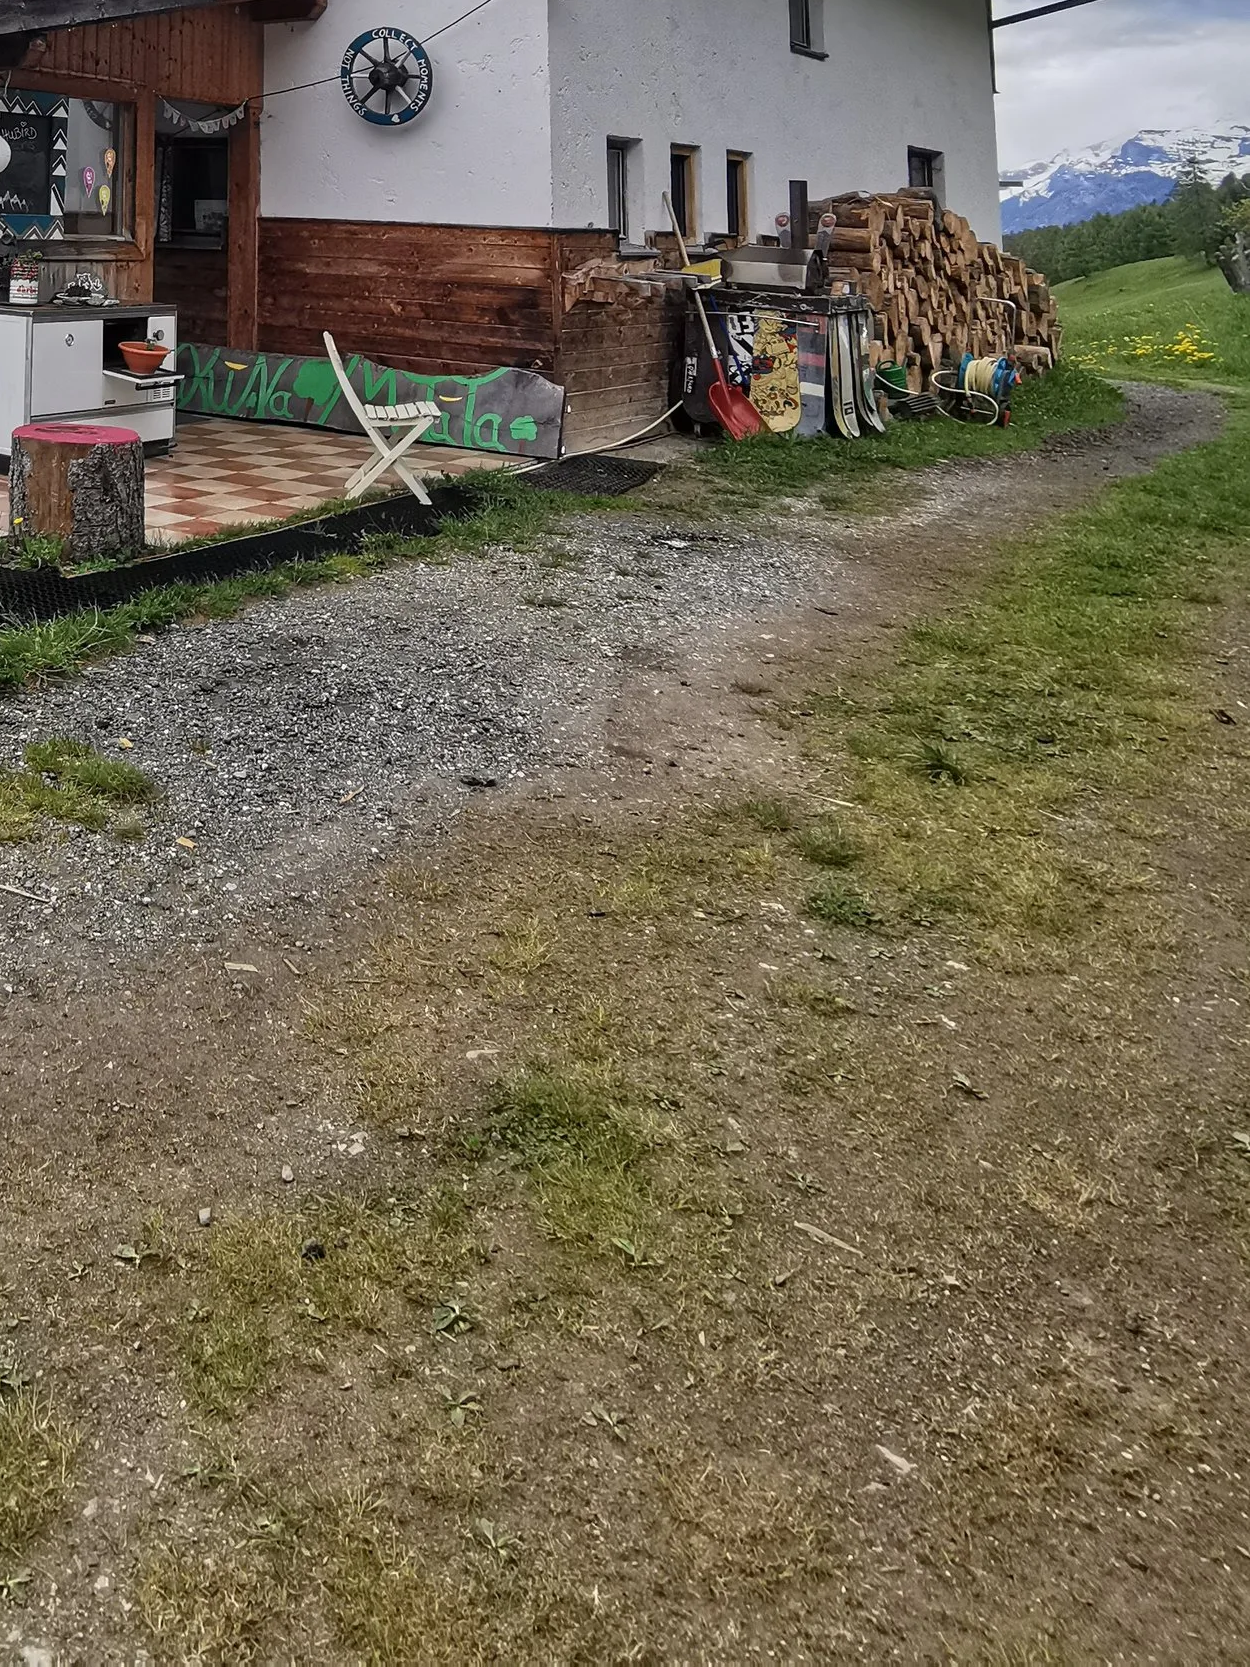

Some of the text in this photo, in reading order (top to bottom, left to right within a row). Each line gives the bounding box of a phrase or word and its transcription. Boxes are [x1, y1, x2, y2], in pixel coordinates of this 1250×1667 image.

[341, 28, 429, 116] COLLECT MOMENTS NOT THINGS
